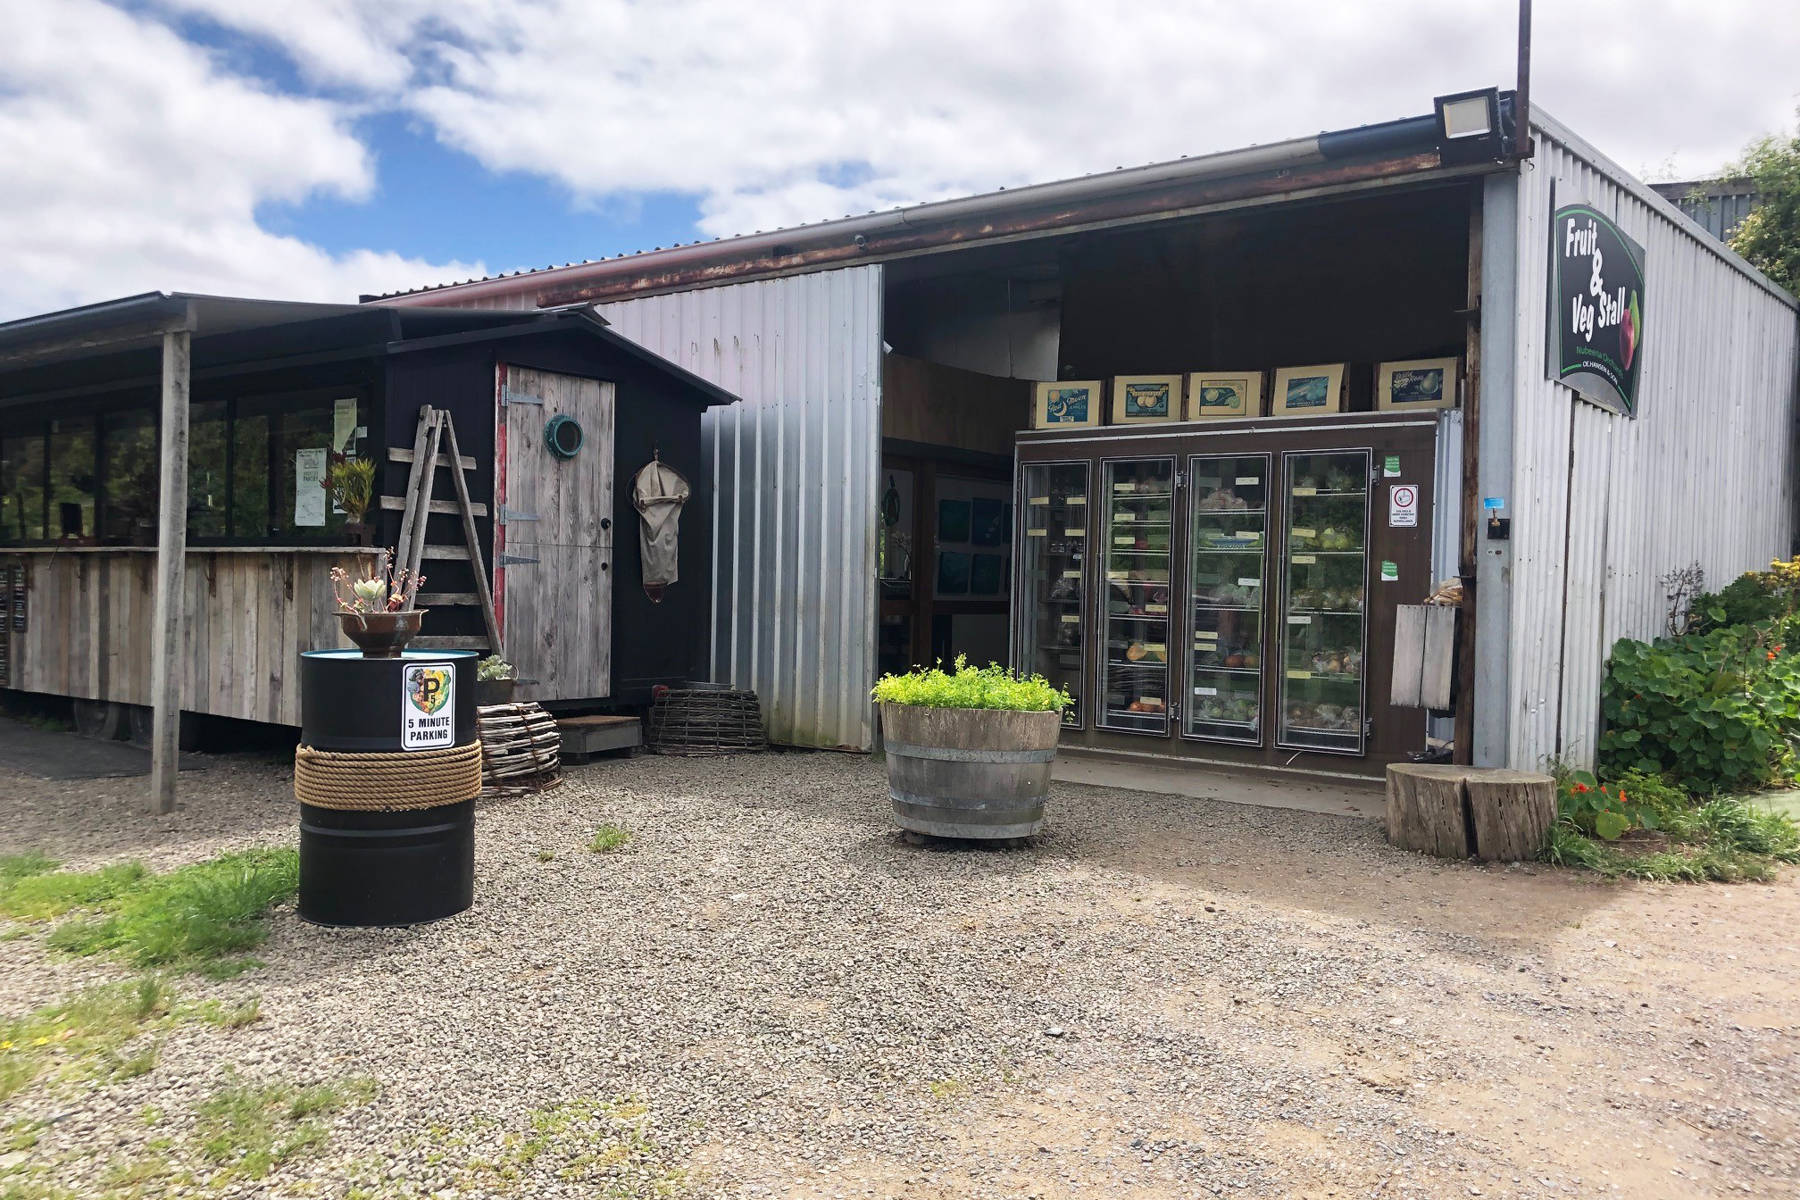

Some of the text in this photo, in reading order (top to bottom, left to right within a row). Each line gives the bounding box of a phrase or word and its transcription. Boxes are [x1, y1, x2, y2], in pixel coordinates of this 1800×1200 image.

[1566, 218, 1598, 257] Fruit
[1590, 248, 1603, 297] &
[1572, 286, 1626, 343] Veg Stall
[423, 677, 440, 701] P
[408, 716, 450, 729] 5 MINUTE
[410, 730, 448, 741] PARKING
